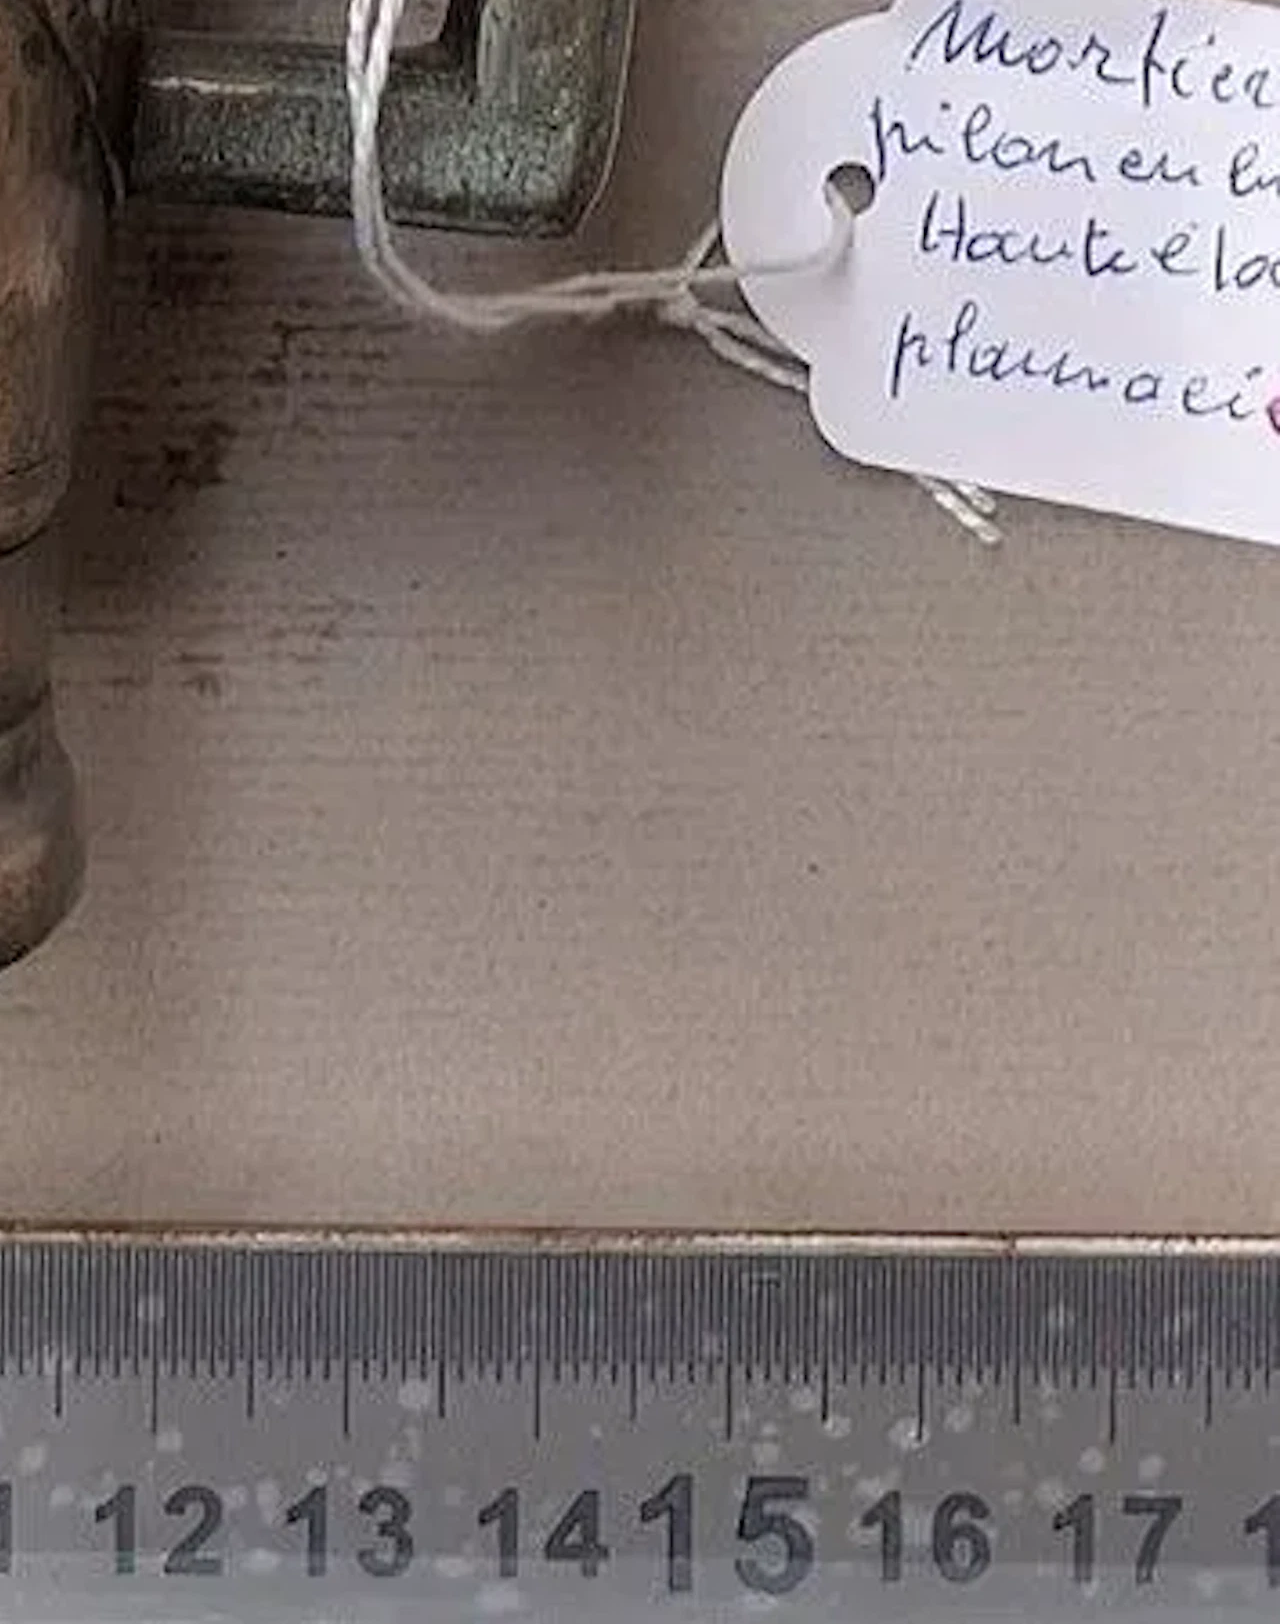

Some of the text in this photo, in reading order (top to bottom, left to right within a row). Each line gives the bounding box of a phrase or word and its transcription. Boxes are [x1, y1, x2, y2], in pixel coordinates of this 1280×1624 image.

[906, 0, 1274, 106] Mortier
[95, 1485, 225, 1576] 12
[285, 1485, 416, 1579] 13
[478, 1488, 610, 1579] 14
[640, 1474, 815, 1595] 15
[861, 1491, 992, 1583] 16
[1052, 1494, 1184, 1586] 17
